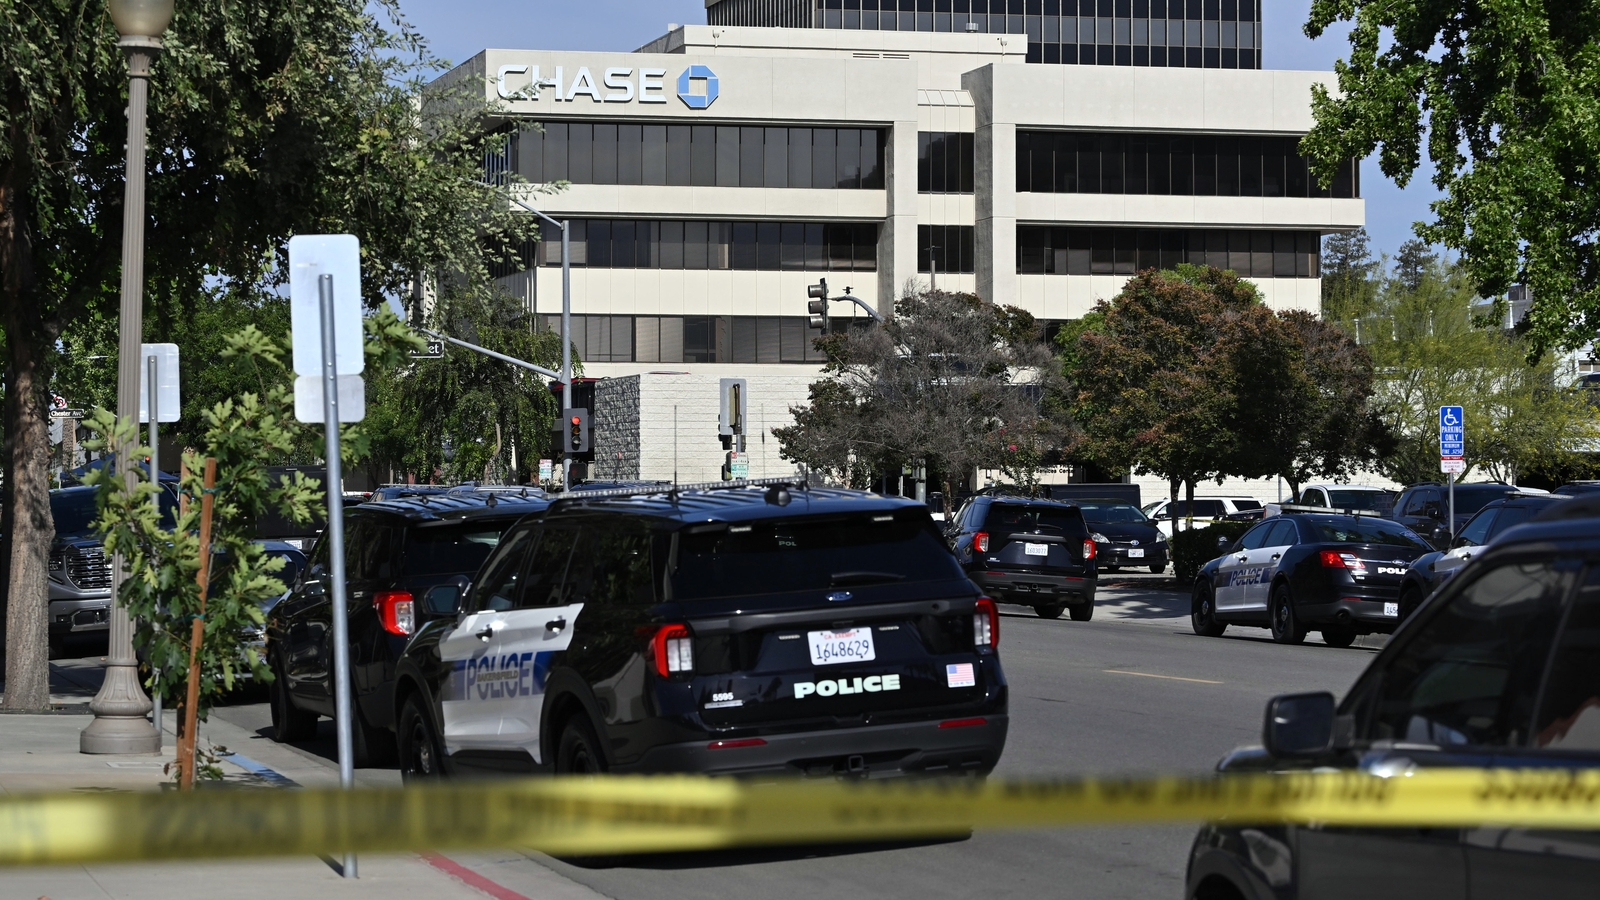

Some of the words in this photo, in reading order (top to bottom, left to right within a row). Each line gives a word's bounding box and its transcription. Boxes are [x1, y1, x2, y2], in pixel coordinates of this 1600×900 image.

[497, 64, 667, 103] CHASE
[1231, 567, 1262, 586] POLICE
[1378, 567, 1408, 575] POLI
[815, 640, 869, 660] 1648629
[467, 652, 533, 700] POLICE
[793, 674, 900, 699] POLICE
